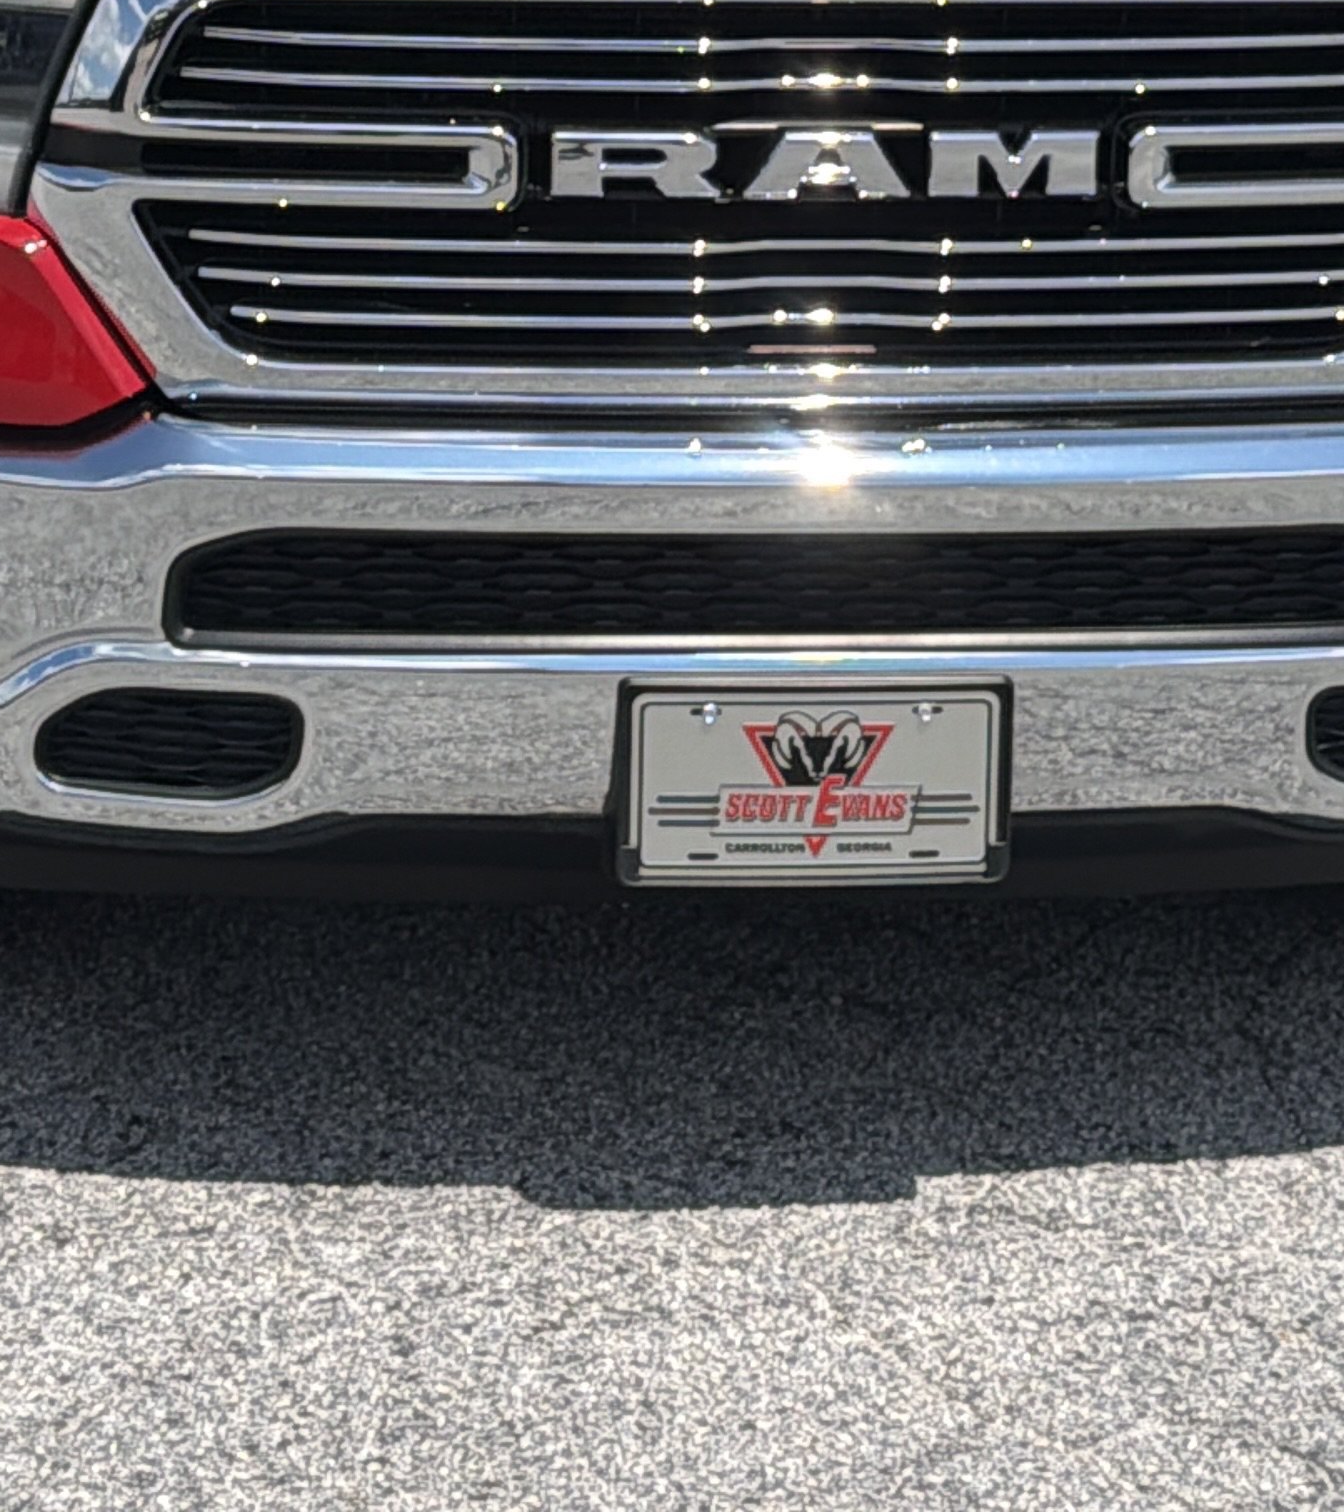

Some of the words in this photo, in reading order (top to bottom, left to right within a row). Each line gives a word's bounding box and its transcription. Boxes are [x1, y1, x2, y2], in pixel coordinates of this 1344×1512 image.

[551, 130, 1100, 199] RAM
[725, 792, 812, 822] SCOTT
[812, 774, 907, 828] EVANS
[725, 842, 806, 854] CARROLLTON
[836, 842, 892, 854] GEORGIA
